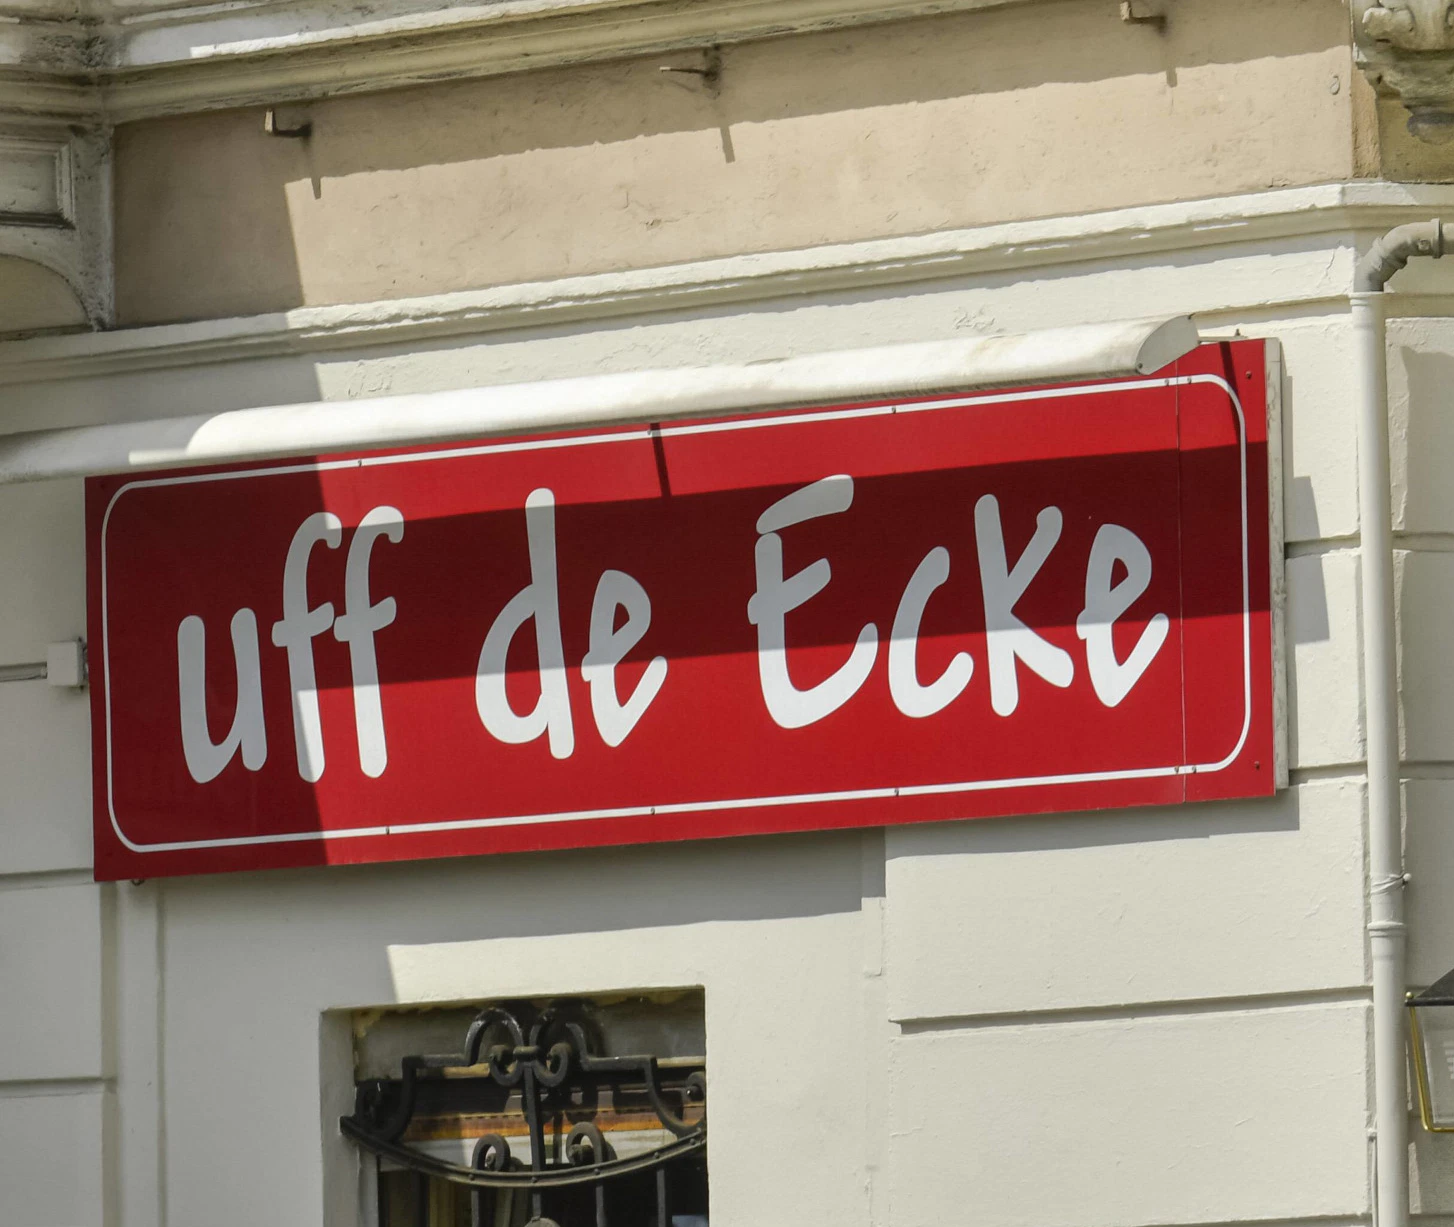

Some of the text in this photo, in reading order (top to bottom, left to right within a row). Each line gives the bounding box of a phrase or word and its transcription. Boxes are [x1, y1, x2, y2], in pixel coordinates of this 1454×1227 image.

[177, 474, 1169, 785] uff de Ecke
